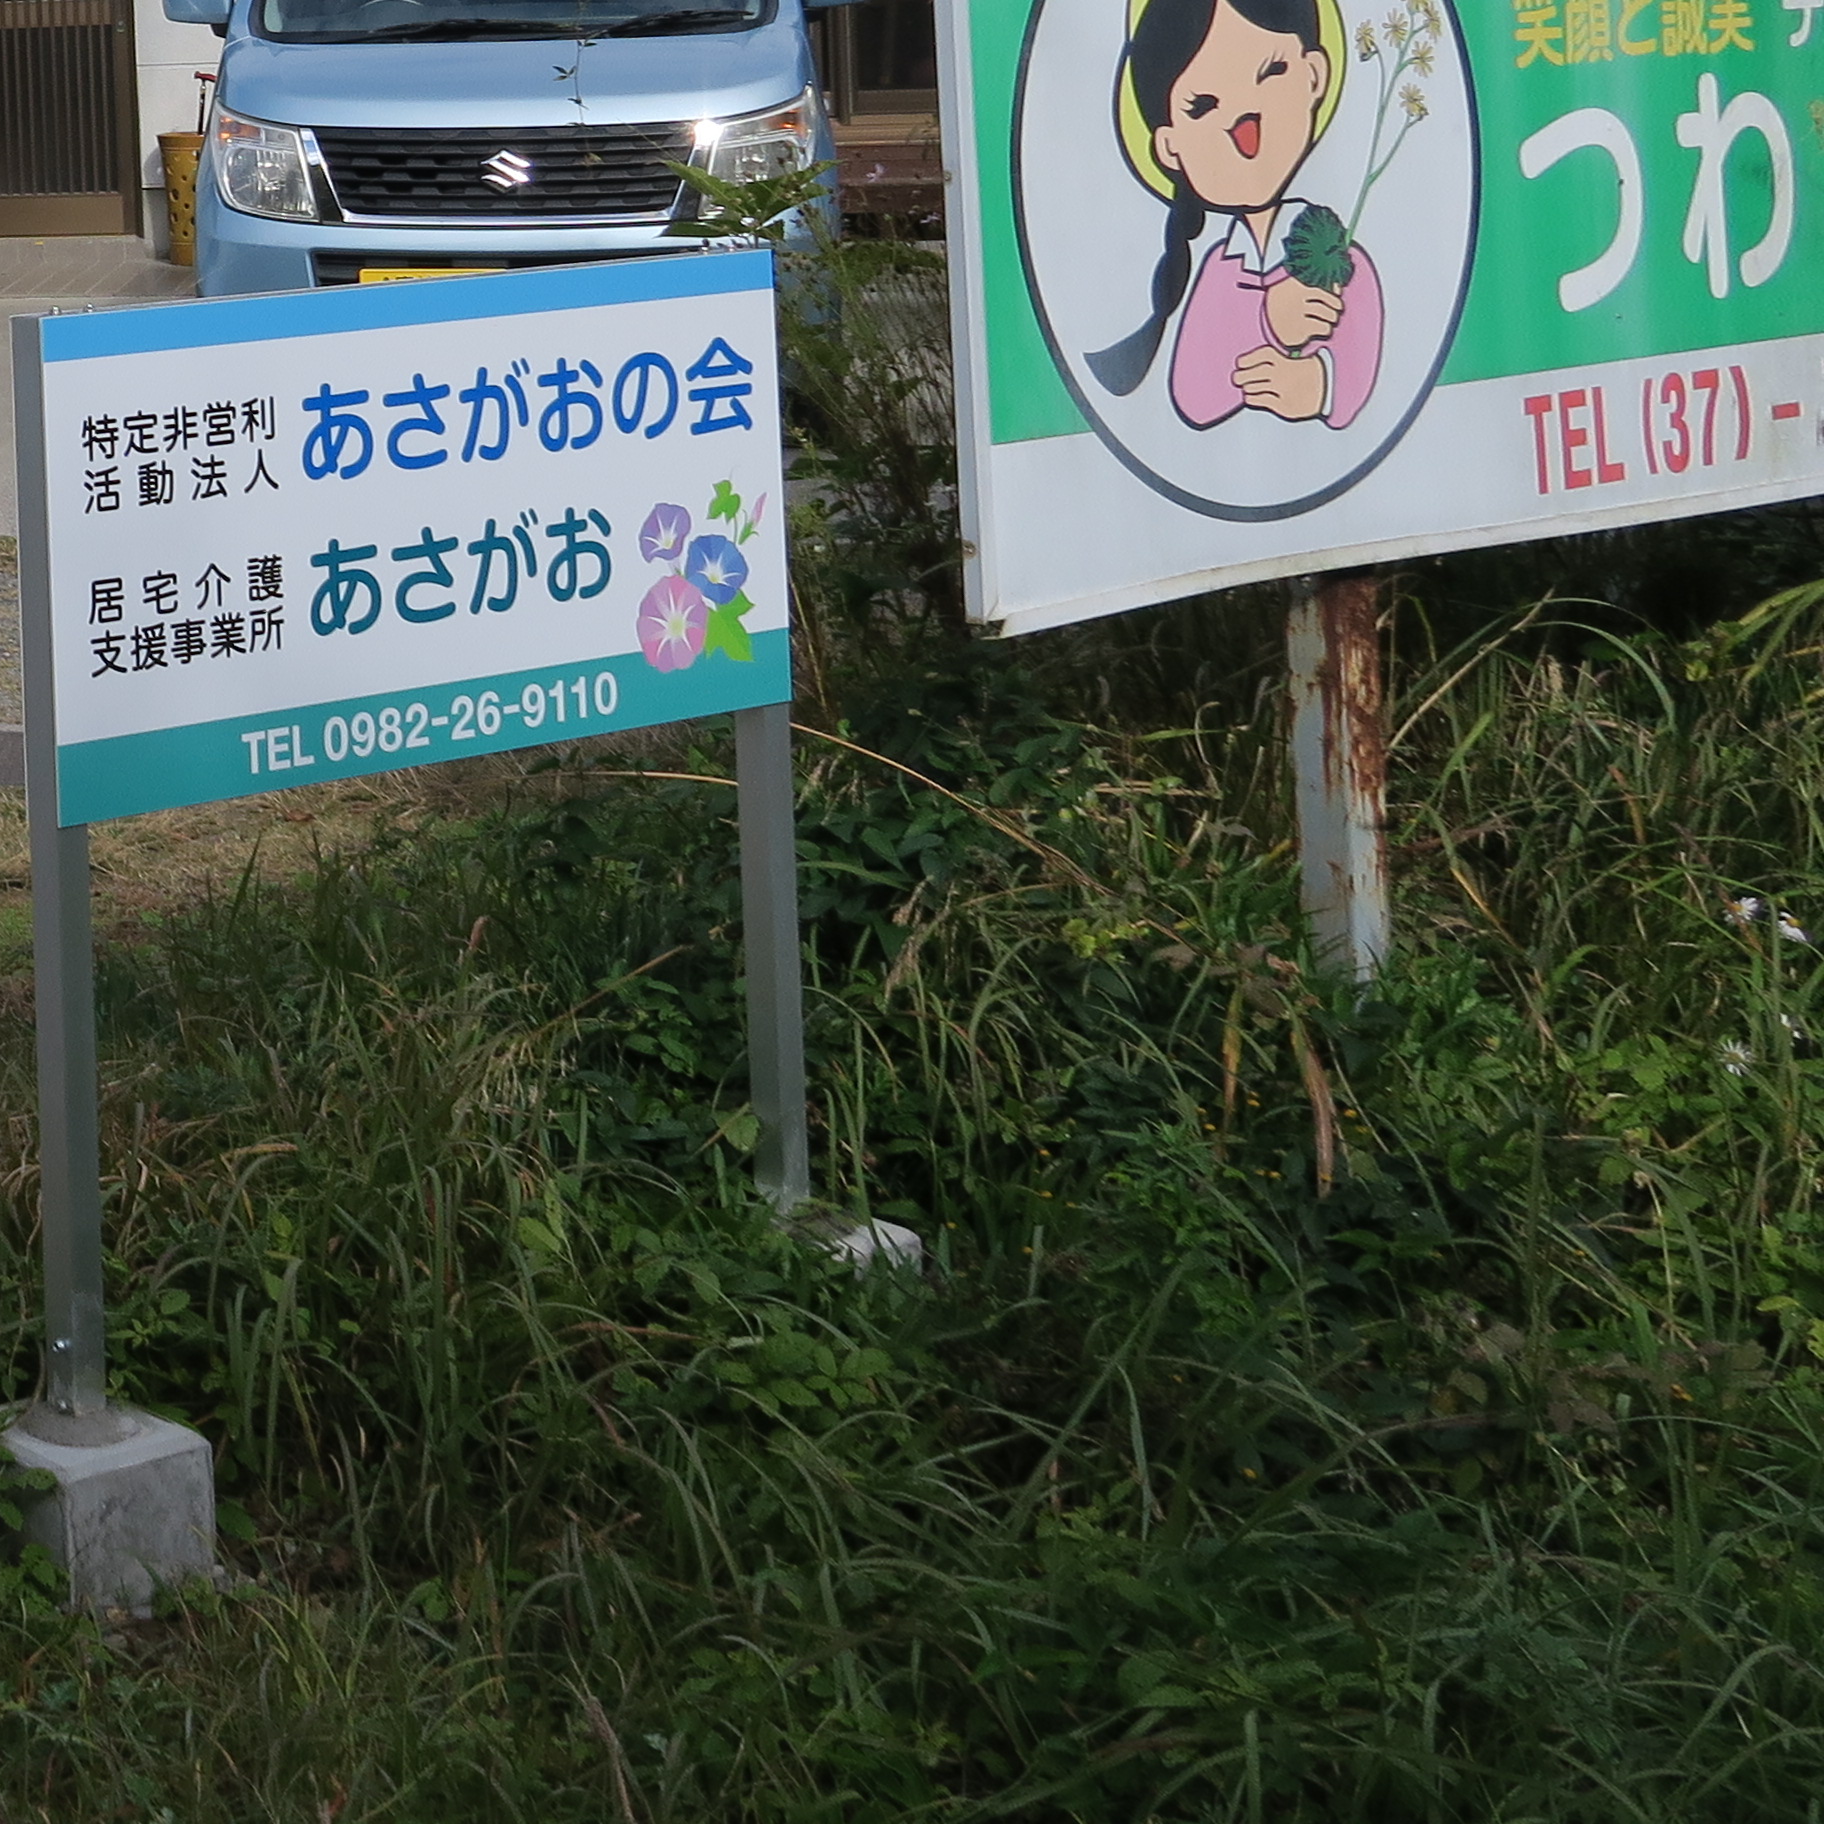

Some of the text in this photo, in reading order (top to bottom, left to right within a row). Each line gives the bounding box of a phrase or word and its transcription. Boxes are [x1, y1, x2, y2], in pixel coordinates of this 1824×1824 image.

[1519, 72, 1795, 313] つわ
[81, 396, 276, 462] 特定非営利
[301, 336, 754, 482] あさがおの会
[1526, 387, 1625, 494] TEL
[84, 448, 280, 514] 活動法人
[88, 554, 285, 626] 居宅介護
[308, 506, 613, 637] あさがお
[89, 604, 285, 679] 支援事業所
[241, 670, 619, 775] TEL 0982-26-9110
